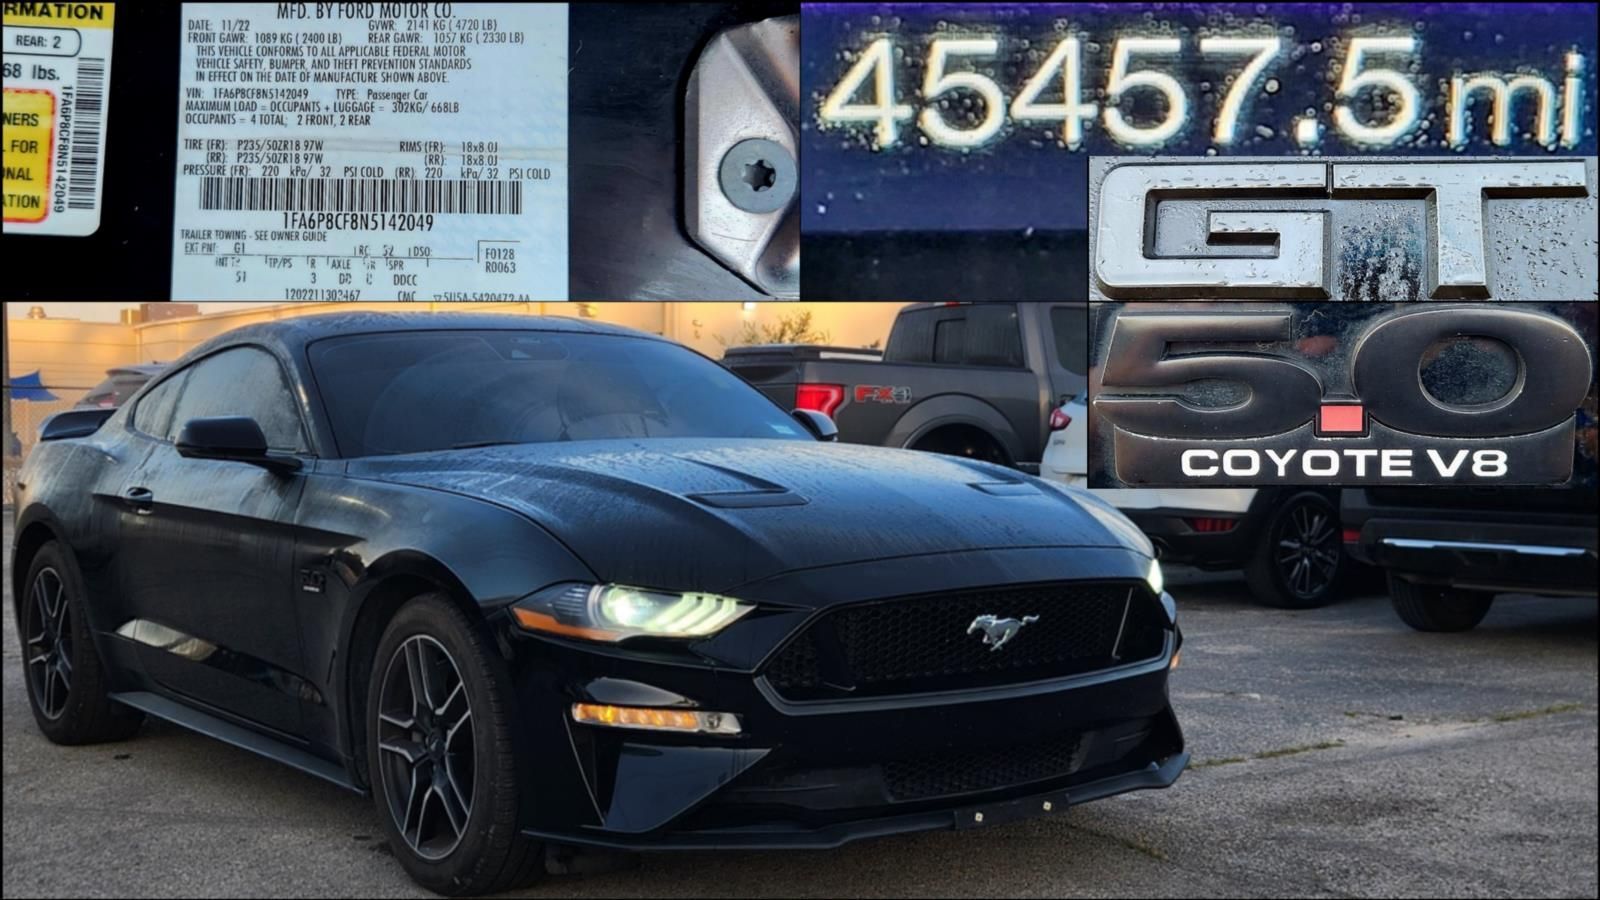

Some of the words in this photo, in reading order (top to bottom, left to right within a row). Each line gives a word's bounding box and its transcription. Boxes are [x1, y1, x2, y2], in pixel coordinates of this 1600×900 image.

[277, 2, 310, 19] MFD.
[316, 2, 333, 19] BY
[338, 2, 374, 19] FORD
[380, 2, 428, 19] MOTOR
[434, 2, 456, 19] CO.
[188, 19, 212, 31] DATE:
[222, 19, 250, 31] 11/22
[368, 19, 397, 31] GVWR:
[407, 19, 428, 31] 2141
[433, 19, 446, 31] KG
[456, 19, 479, 31] 4720
[482, 19, 497, 31] LB)
[16, 35, 48, 48] REAR:
[53, 35, 61, 48] 2
[188, 32, 216, 44] FRONT
[219, 32, 248, 44] GAWR:
[256, 32, 277, 44] 1089
[280, 32, 292, 44] KG
[302, 32, 324, 44] 2400
[327, 32, 342, 44] LB)
[368, 32, 390, 44] REAR
[393, 32, 423, 44] GAWR:
[434, 32, 456, 44] 1057
[460, 32, 472, 44] KG
[483, 32, 506, 44] 2330
[510, 32, 524, 44] LB)
[197, 45, 215, 57] THIS
[218, 45, 252, 57] VEHICLE
[256, 45, 303, 57] CONFORMS
[307, 45, 318, 57] TO
[320, 45, 335, 57] ALL
[339, 45, 389, 57] APPLICABLE
[393, 45, 430, 57] FEDERAL
[434, 45, 465, 57] MOTOR
[196, 58, 230, 70] VEHICLE
[234, 58, 266, 71] SAFETY,
[270, 58, 308, 71] BUMPER,
[311, 58, 330, 70] AND
[334, 58, 358, 70] THEFT
[362, 58, 415, 70] PREVENTION
[419, 58, 472, 70] STANDARDS
[32, 64, 60, 80] lbs.
[196, 71, 205, 83] IN
[208, 71, 237, 83] EFFECT
[240, 71, 253, 83] ON
[256, 71, 272, 83] THE
[275, 71, 297, 83] DATE
[300, 71, 310, 83] OF
[314, 71, 377, 83] MANUFACTURE
[381, 71, 414, 83] SHOWN
[417, 71, 449, 83] ABOVE.
[186, 88, 204, 100] VIN:
[213, 88, 308, 100] 1FA6P8CF8N5142049
[336, 88, 359, 100] TYPE:
[367, 89, 410, 102] Passenger
[414, 89, 427, 100] Car
[821, 35, 1421, 149] 45457.5
[1449, 49, 1585, 148] mi
[185, 102, 231, 112] MAXIMUM
[234, 102, 257, 112] LOAD
[270, 102, 321, 112] OCCUPANTS
[334, 102, 375, 113] LUGGAGE
[431, 102, 459, 113] 668LB
[185, 114, 236, 125] OCCUPANTS
[250, 114, 256, 125] 4
[297, 114, 302, 125] 2
[305, 114, 336, 127] FRONT,
[340, 114, 345, 125] 2
[349, 114, 370, 125] REAR
[11, 140, 38, 154] FOR
[184, 139, 204, 150] TIRE
[207, 139, 227, 150] (FR):
[237, 139, 300, 150] P235/50ZR18
[304, 139, 323, 150] 97W
[400, 142, 422, 153] RIMS
[424, 142, 446, 153] (FR):
[206, 152, 227, 164] (RR):
[237, 152, 300, 164] P235/50ZR18
[304, 152, 323, 164] 97W
[424, 155, 446, 166] (RR):
[183, 165, 226, 177] PRESSURE
[230, 165, 250, 177] (FR):
[262, 166, 279, 177] 220
[290, 166, 312, 177] kPa/
[320, 167, 331, 177] 32
[344, 167, 357, 177] PSI
[360, 167, 384, 178] COLD
[395, 168, 416, 179] (RR):
[425, 168, 442, 179] 220
[461, 168, 484, 179] kPa/
[487, 168, 499, 179] 32
[509, 168, 523, 179] PSI
[526, 168, 550, 179] COLD
[283, 212, 433, 231] 1FA6P8CF8N5142049
[181, 229, 212, 241] TRAILER
[215, 229, 246, 241] TOWING
[254, 230, 268, 241] SEE
[271, 230, 300, 241] OWNER
[302, 231, 327, 242] GUIDE
[1096, 159, 1591, 300] GT
[269, 257, 292, 269] TP/PS
[331, 259, 351, 270] AXLE
[389, 260, 404, 270] SPR
[311, 273, 317, 284] 3
[1094, 304, 1593, 439] 5.0
[1181, 447, 1415, 478] COYOTE
[1426, 447, 1508, 478] V8
